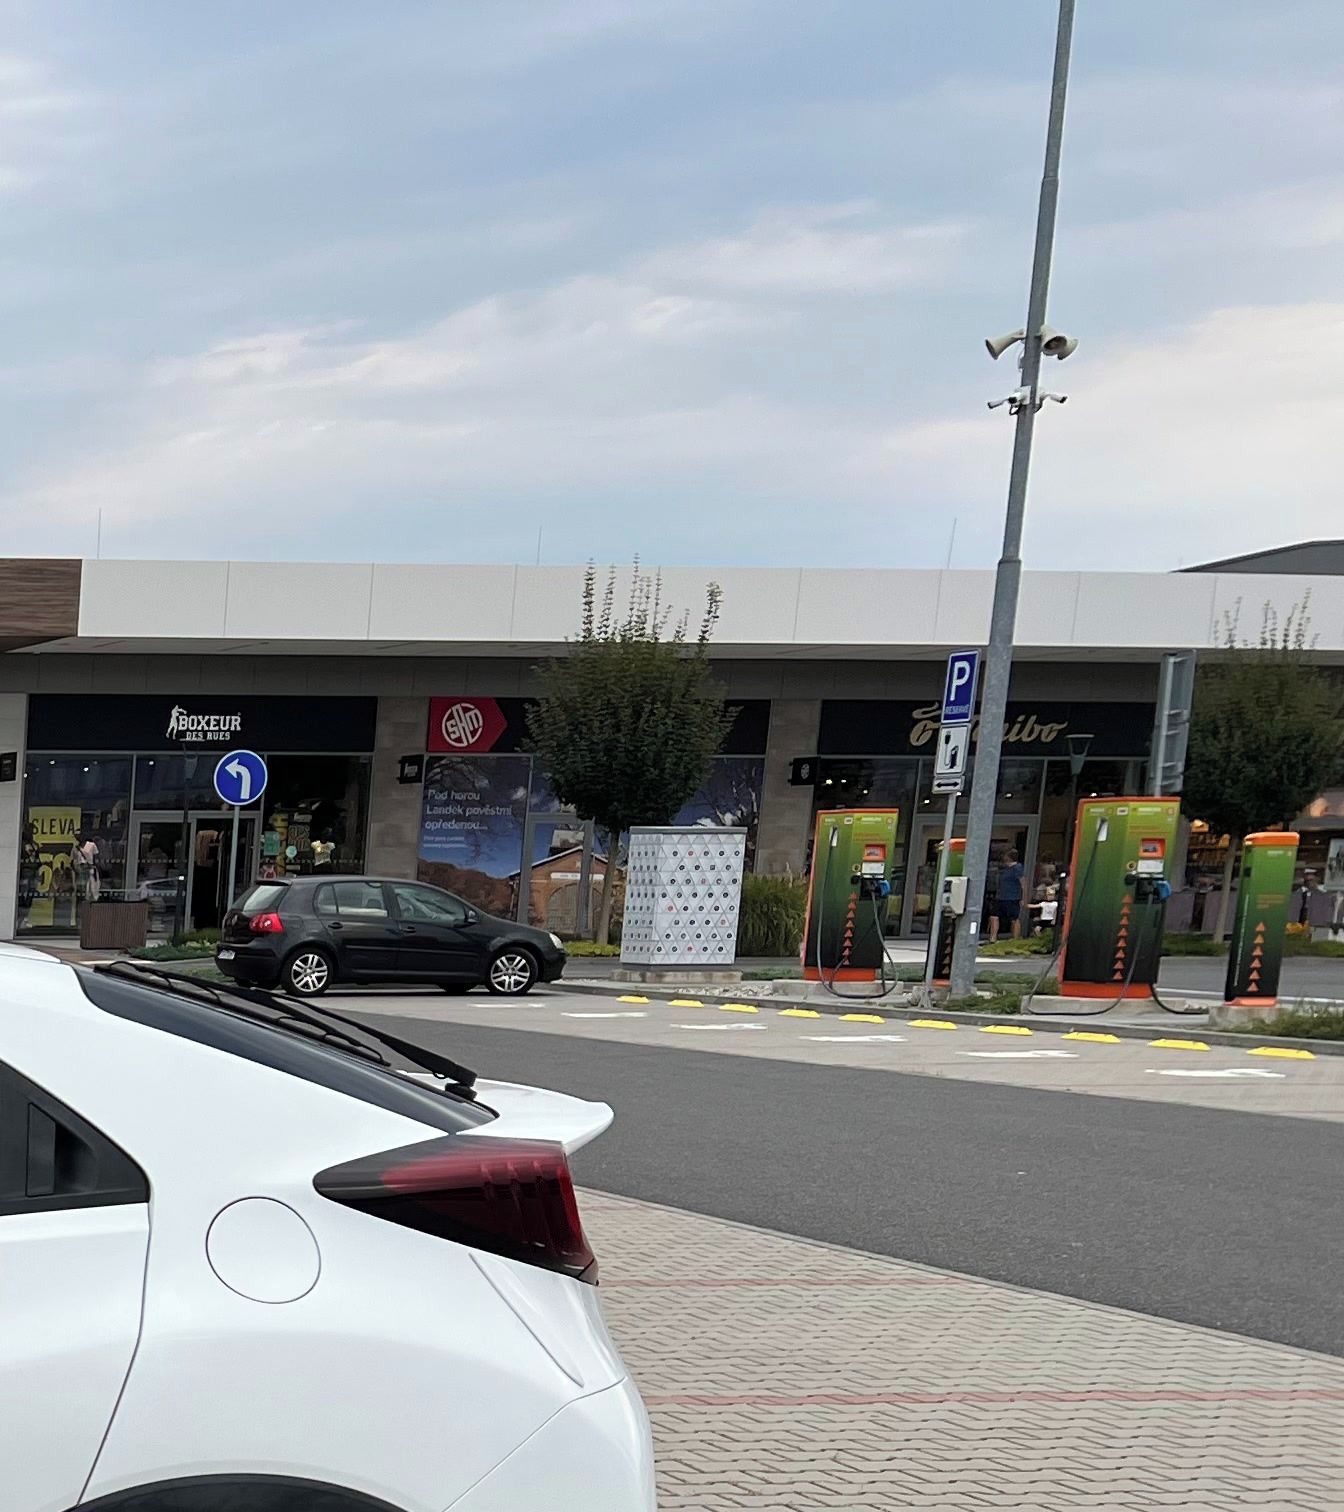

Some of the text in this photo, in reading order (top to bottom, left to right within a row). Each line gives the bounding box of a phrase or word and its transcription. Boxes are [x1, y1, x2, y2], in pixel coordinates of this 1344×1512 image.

[950, 660, 971, 702] P
[177, 715, 242, 731] BOXEUR
[185, 731, 231, 741] DES RUES
[426, 804, 464, 815] Landek
[32, 818, 75, 835] SLEVA
